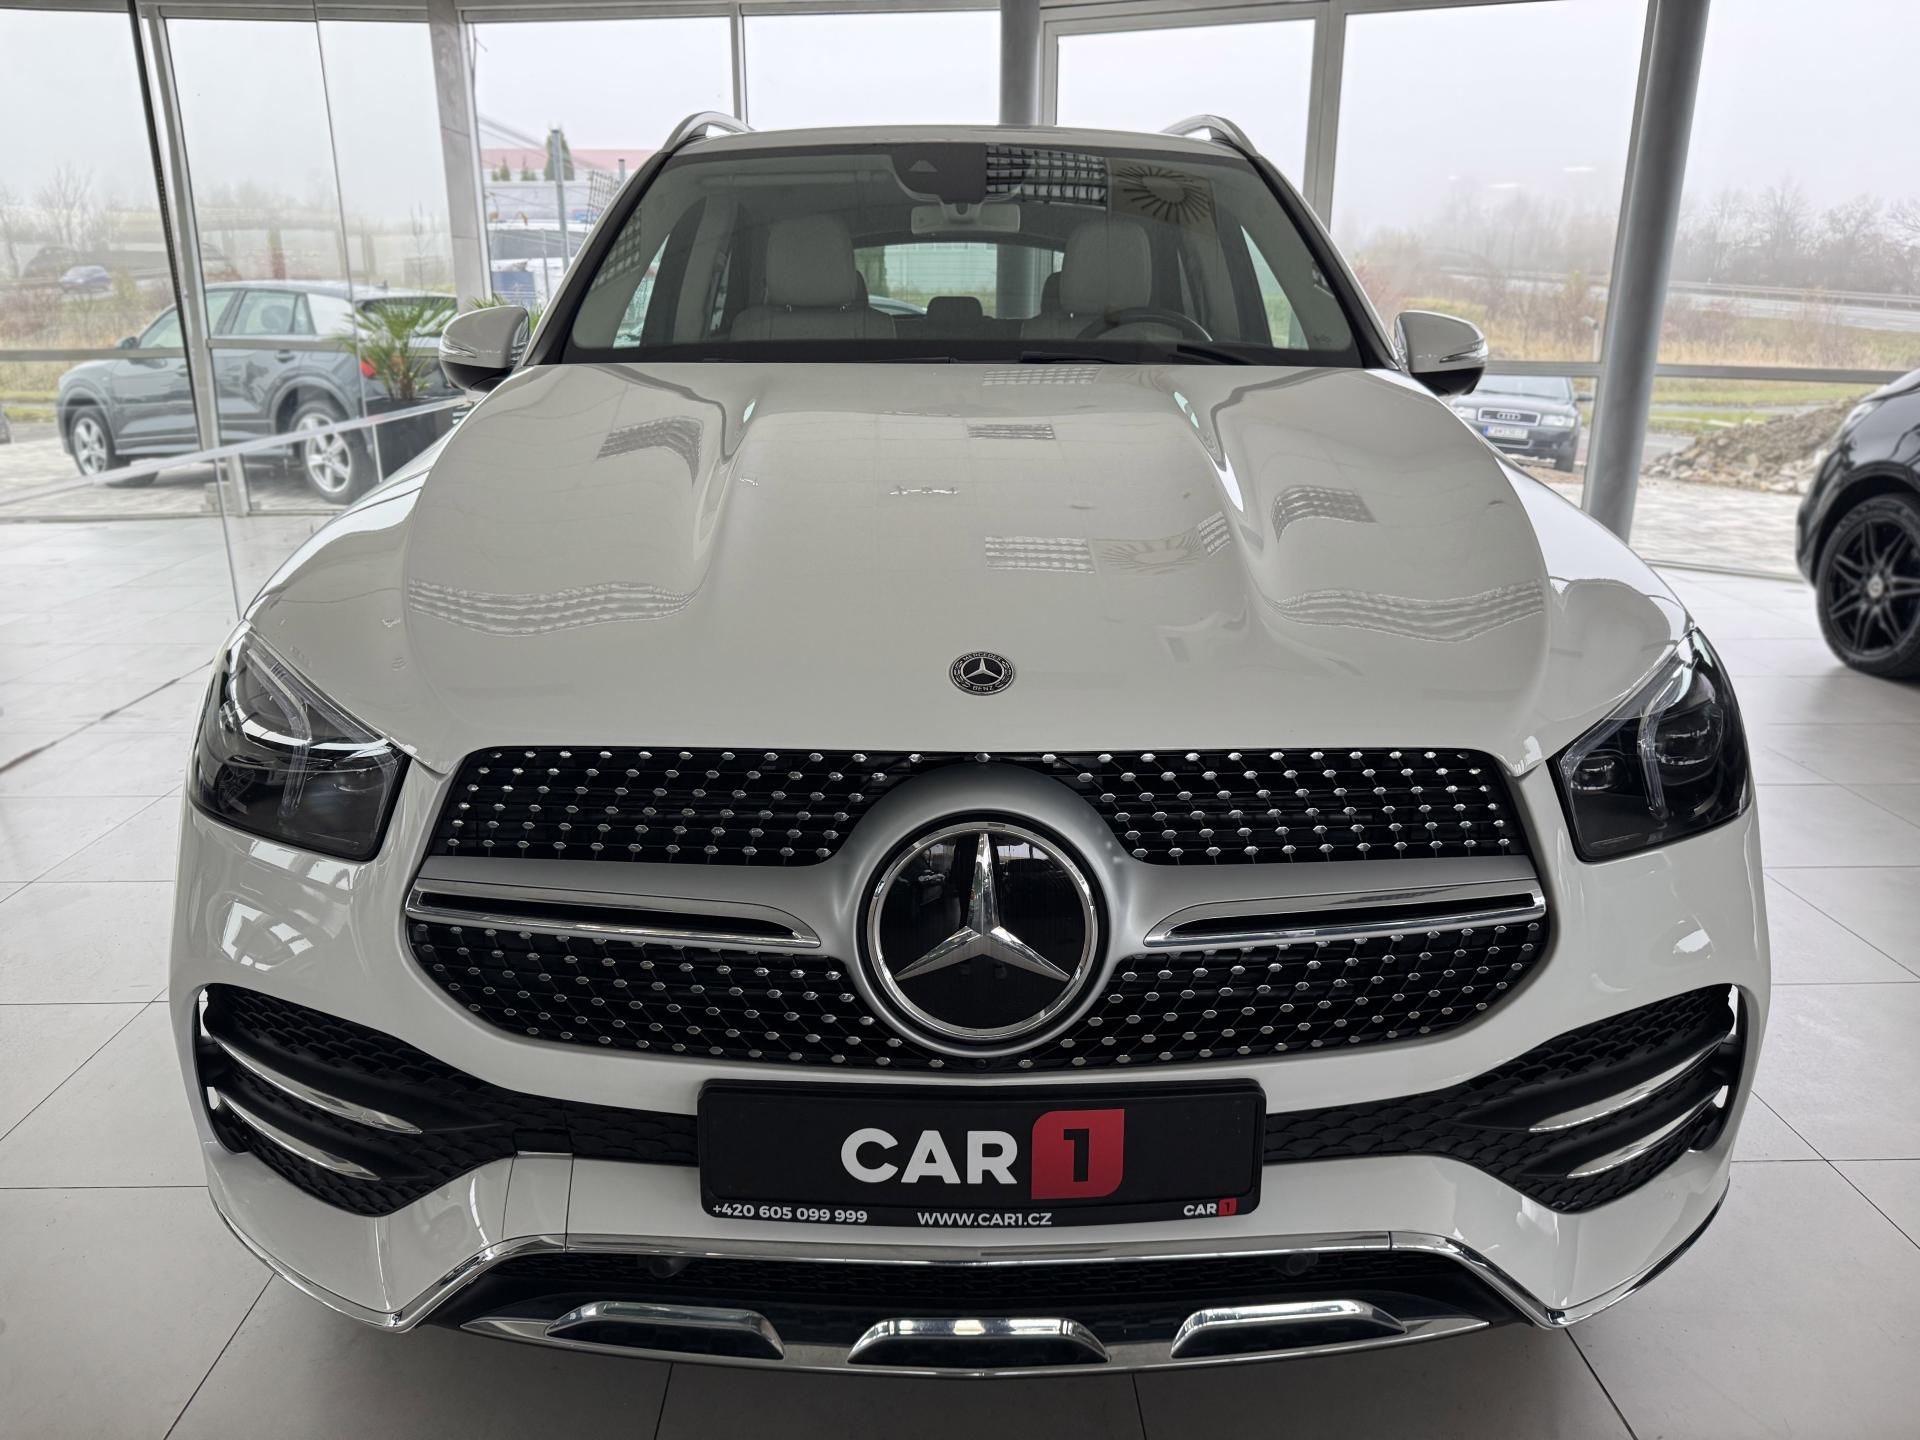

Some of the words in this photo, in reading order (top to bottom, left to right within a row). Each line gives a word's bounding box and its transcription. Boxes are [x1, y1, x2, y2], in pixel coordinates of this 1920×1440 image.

[840, 1127, 1018, 1185] CAR
[1063, 1128, 1090, 1183] 1
[712, 1203, 755, 1217] +420
[758, 1205, 793, 1220] 605
[796, 1207, 831, 1222] 099
[834, 1209, 868, 1223] 999
[1183, 1202, 1217, 1217] CAR
[916, 1212, 1053, 1226] WWW.CAR1.CZ
